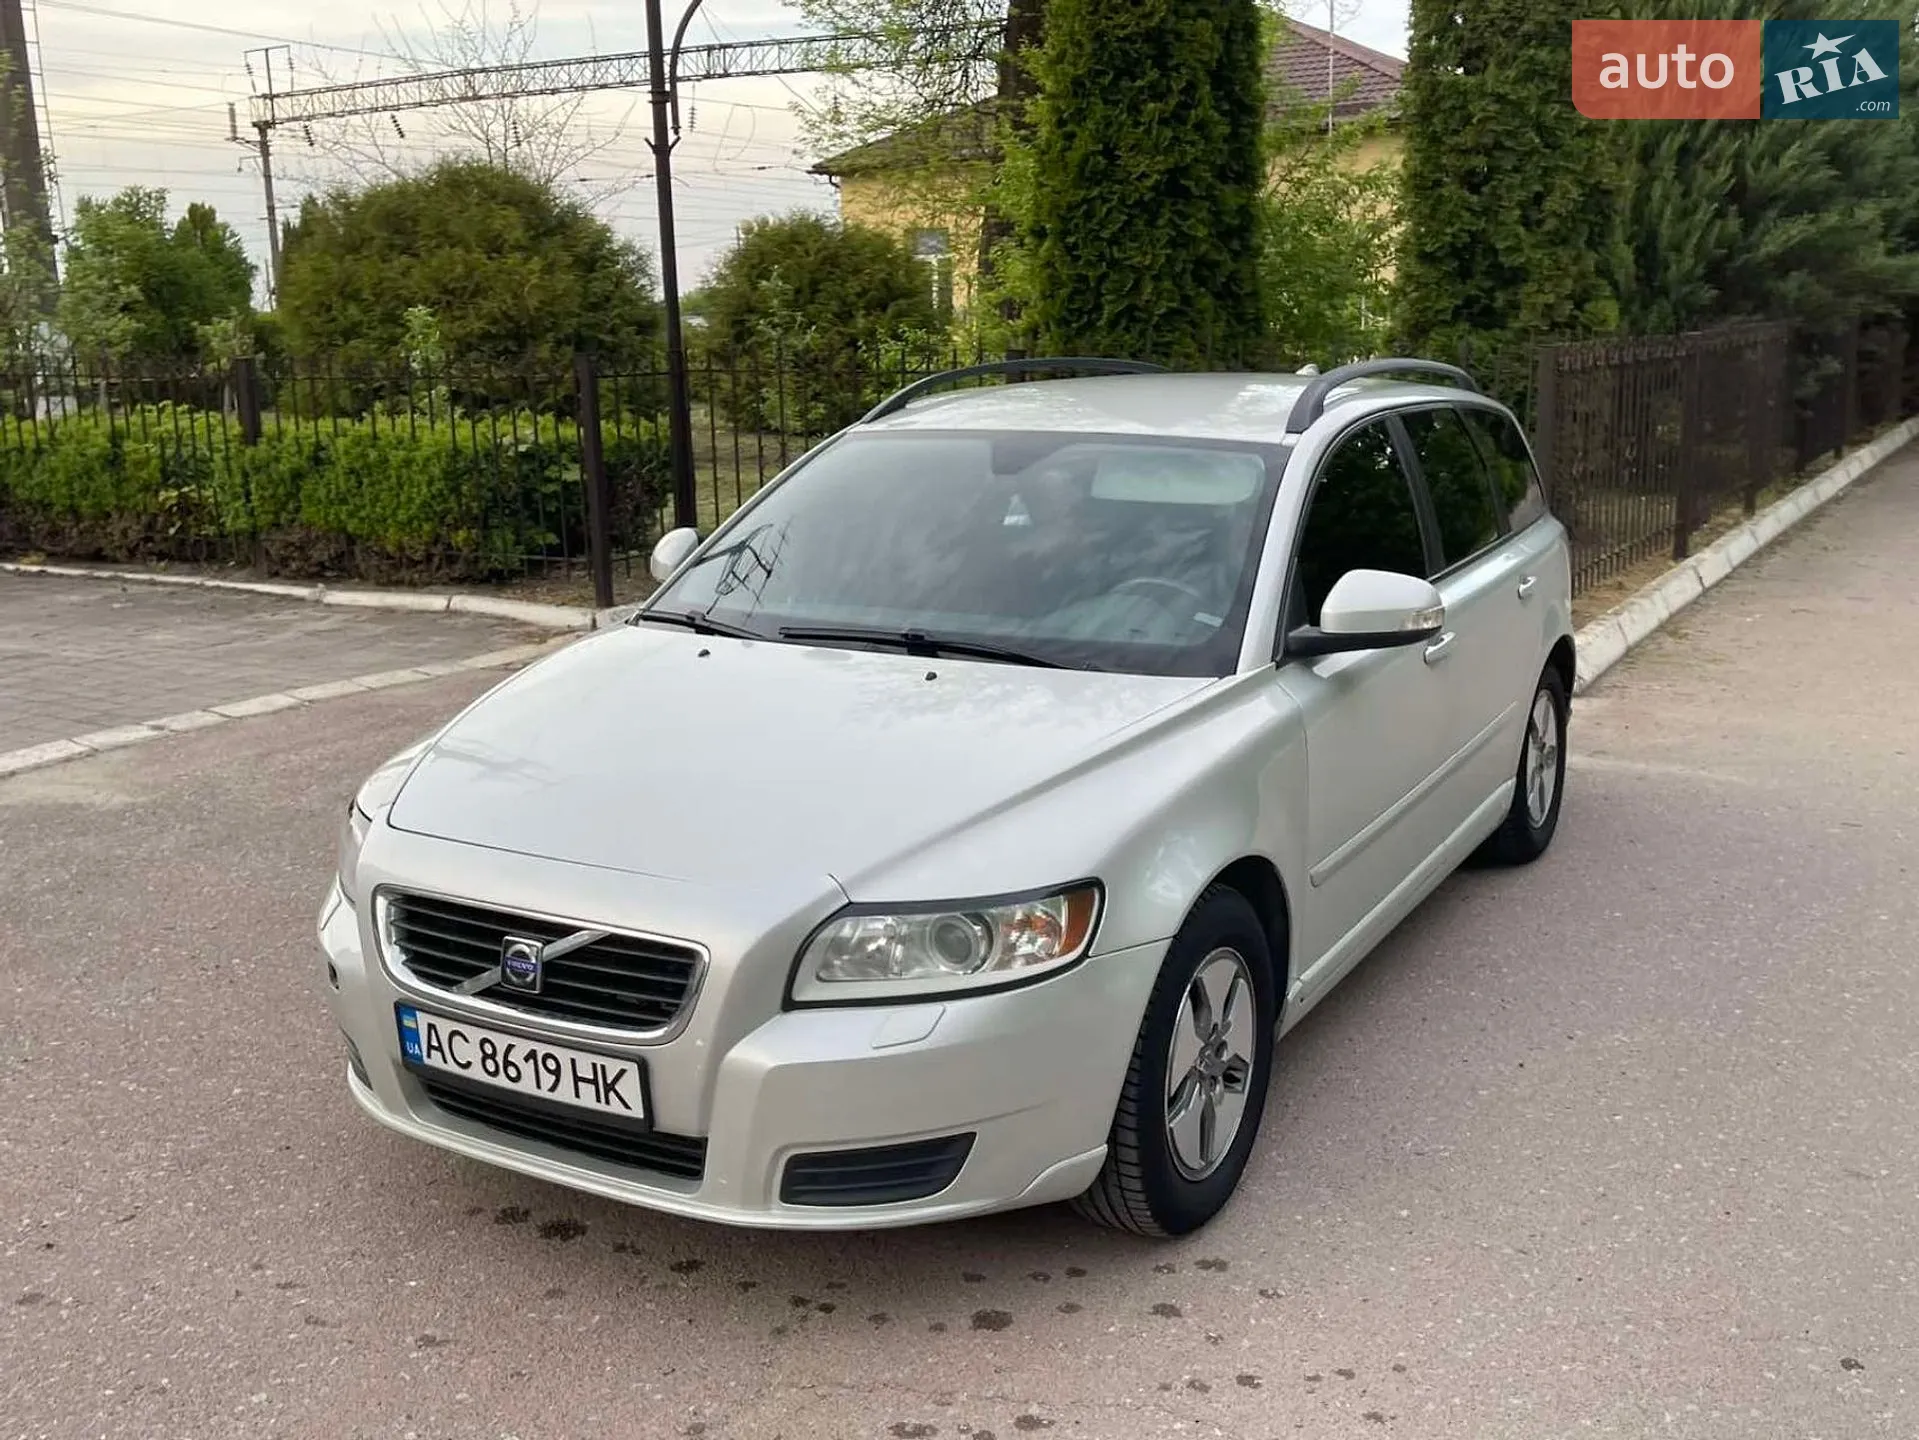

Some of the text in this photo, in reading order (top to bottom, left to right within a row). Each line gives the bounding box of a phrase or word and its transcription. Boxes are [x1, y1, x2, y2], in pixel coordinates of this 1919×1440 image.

[407, 1042, 421, 1055] UA
[426, 1022, 632, 1110] AC 8619 HK
